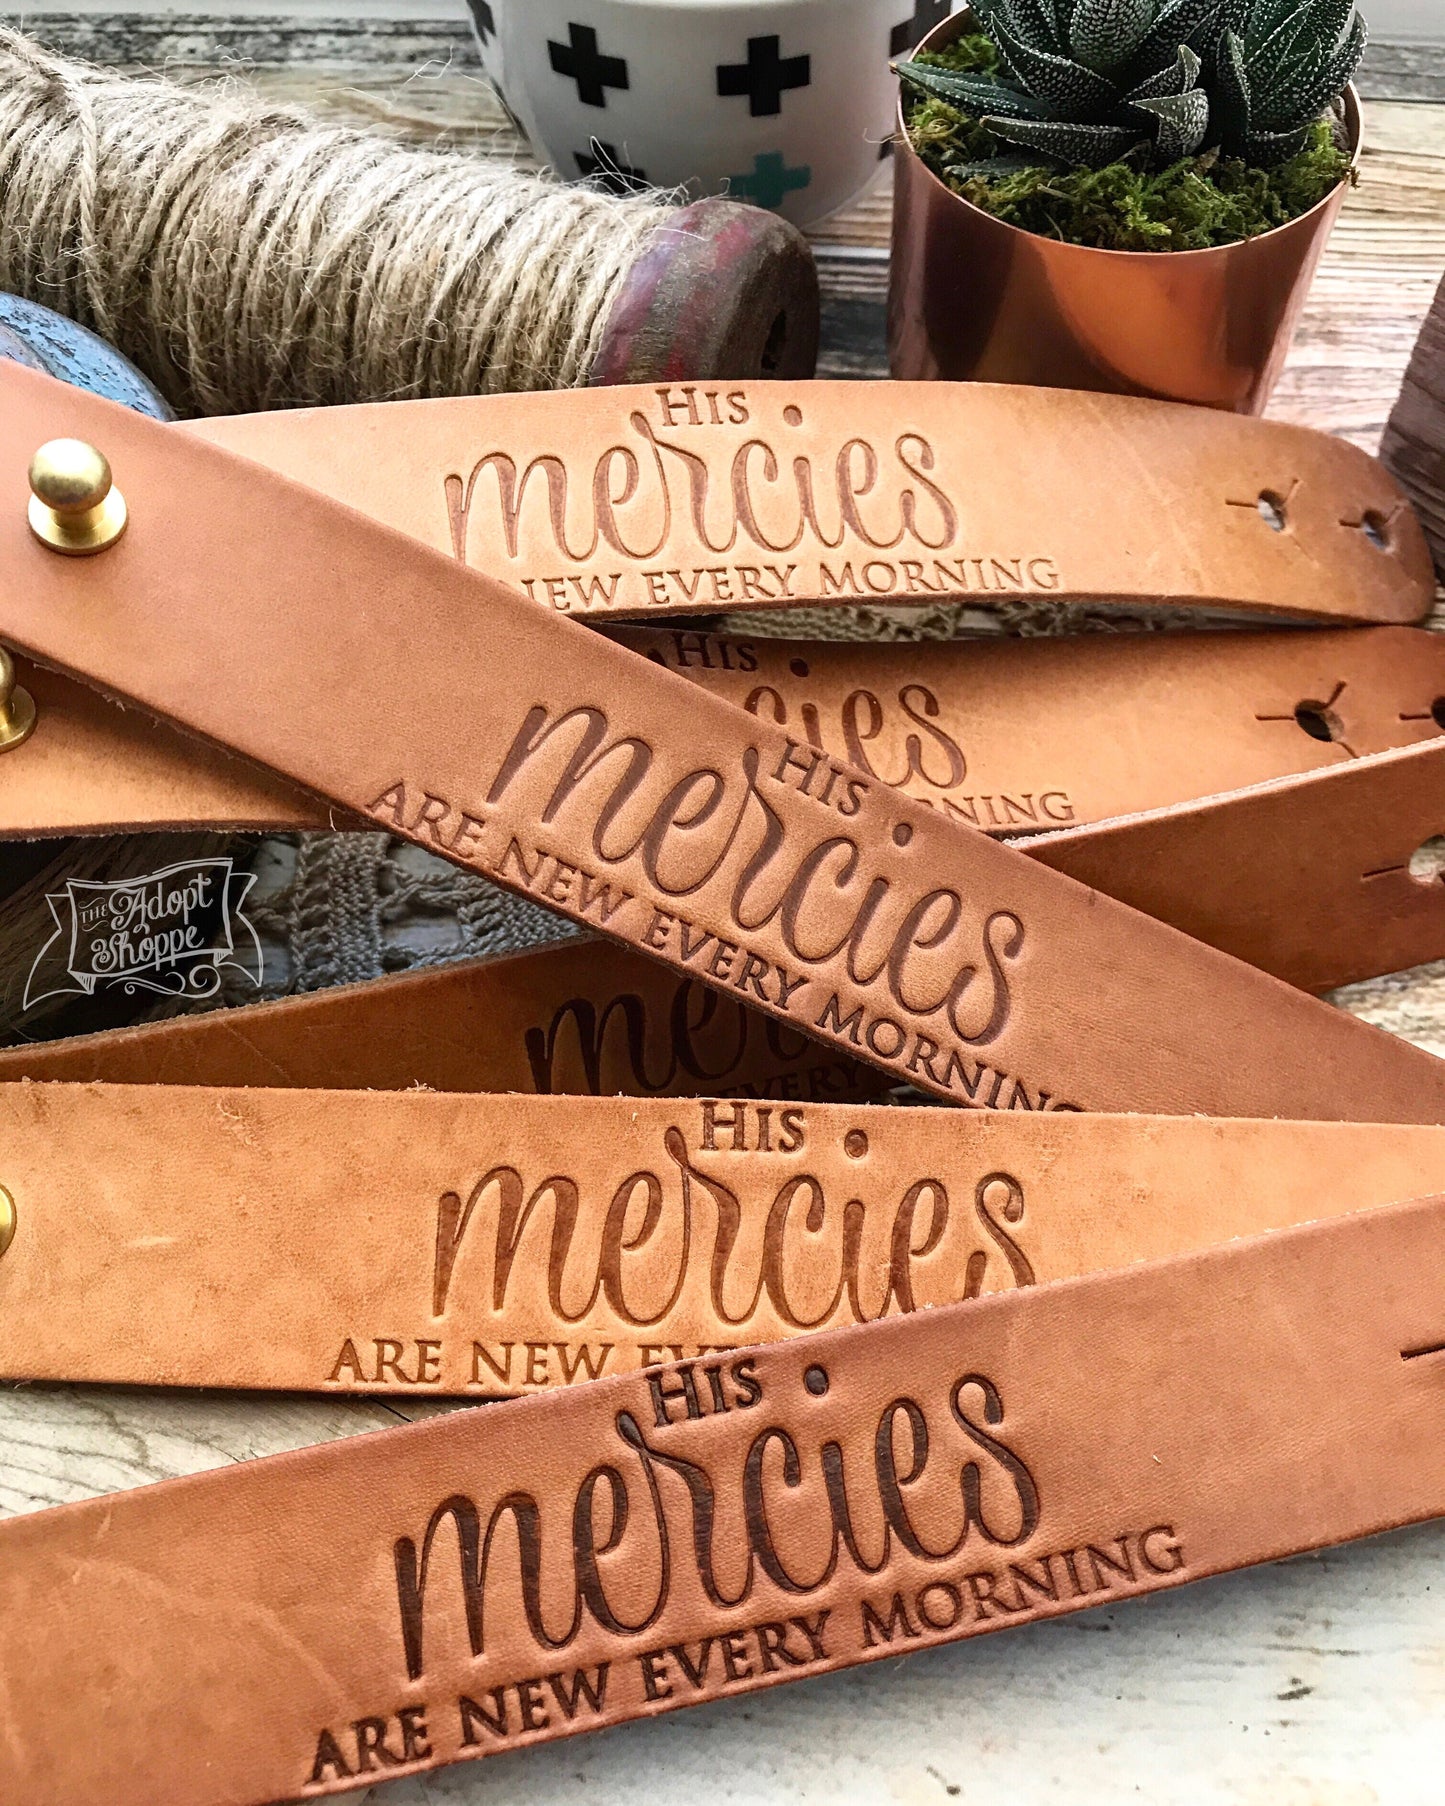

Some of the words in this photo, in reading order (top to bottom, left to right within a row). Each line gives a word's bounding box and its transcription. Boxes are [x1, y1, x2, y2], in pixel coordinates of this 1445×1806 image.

[655, 386, 750, 428] HIS
[444, 404, 959, 563] mercies
[641, 564, 797, 605] EVERY
[819, 558, 1059, 595] MORNING
[771, 735, 870, 817] HIS
[487, 704, 1025, 1047] mercies
[364, 780, 486, 858] ARE
[493, 836, 635, 924] NEW
[640, 906, 809, 1010] EVERY
[815, 992, 1086, 1112] MORNIN
[700, 1100, 804, 1152] HIS
[325, 1337, 443, 1385] ARE
[467, 1341, 615, 1385] NEW
[645, 1358, 762, 1428] HIS
[393, 1364, 1042, 1682] mercies
[304, 1703, 433, 1785] ARE
[458, 1661, 611, 1748] NEW
[637, 1609, 832, 1702] EVERY
[860, 1524, 1185, 1650] MORNING
